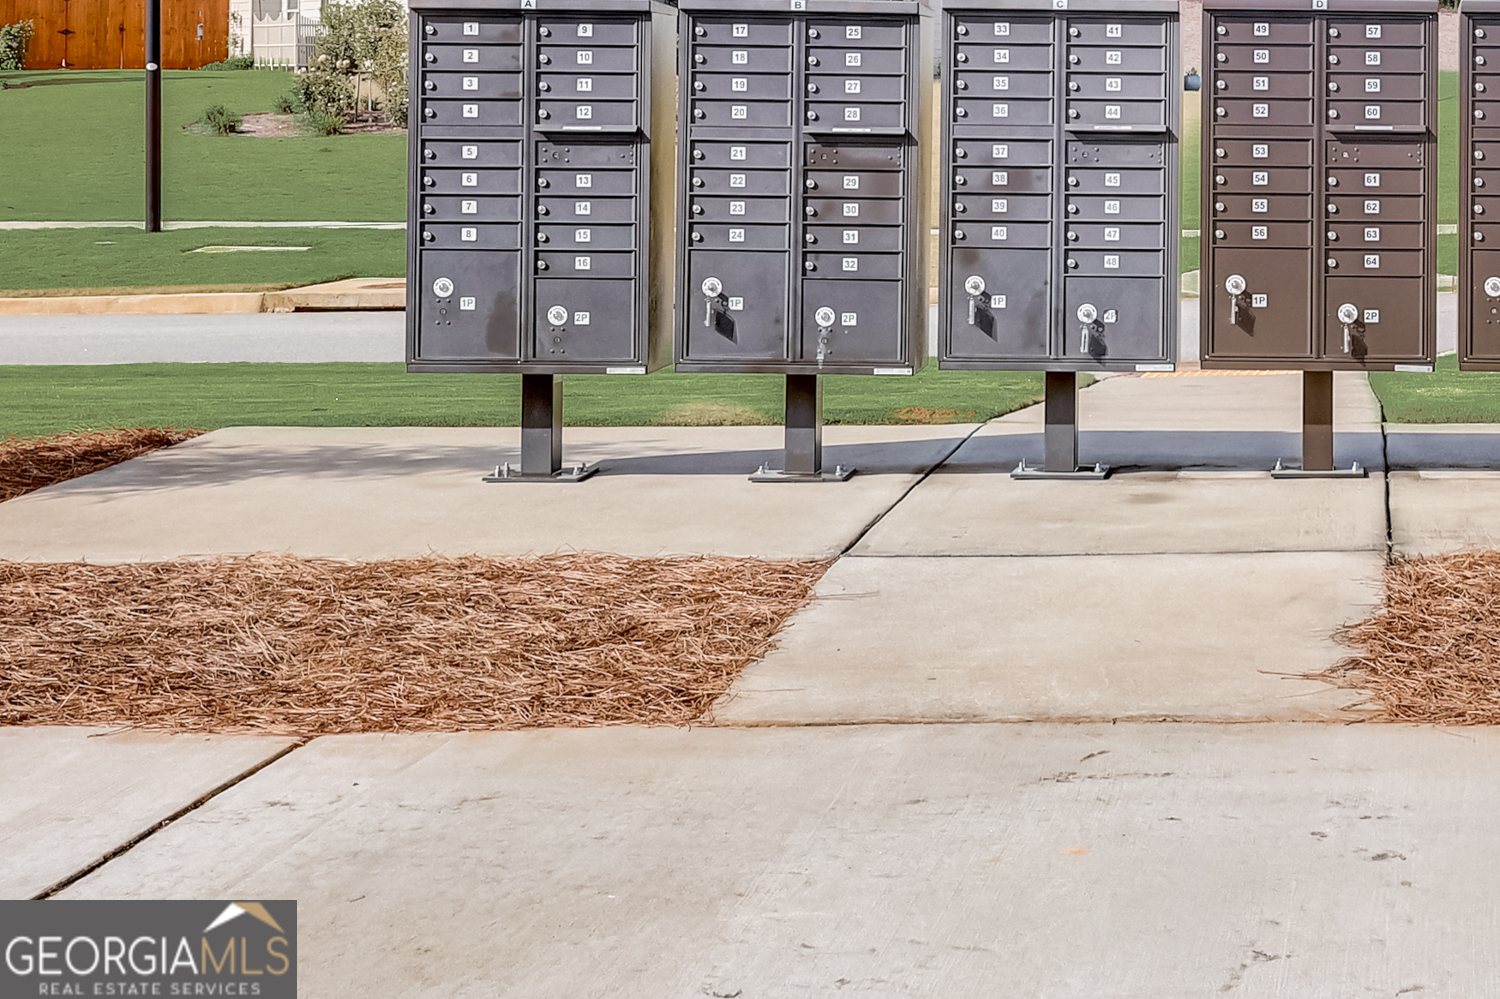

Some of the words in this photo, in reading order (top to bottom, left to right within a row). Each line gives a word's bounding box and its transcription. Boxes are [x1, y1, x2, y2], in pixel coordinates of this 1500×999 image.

[524, 0, 532, 8] A
[794, 1, 802, 9] B
[1056, 0, 1064, 8] C
[1316, 0, 1324, 8] D
[468, 24, 473, 33] 1
[581, 25, 588, 34] 9
[735, 26, 746, 35] 17
[847, 27, 860, 37] 25
[996, 24, 1008, 34] 33
[1108, 26, 1119, 35] 41
[1255, 24, 1267, 34] 49
[1367, 26, 1379, 36] 57
[467, 51, 474, 60] 2
[579, 52, 590, 62] 10
[734, 53, 746, 62] 18
[847, 55, 859, 64] 26
[996, 51, 1008, 61] 34
[1107, 53, 1119, 62] 42
[1255, 51, 1267, 61] 50
[1367, 53, 1379, 63] 58
[467, 78, 474, 88] 3
[578, 80, 589, 89] 11
[734, 80, 746, 89] 19
[847, 82, 859, 91] 27
[995, 78, 1006, 88] 35
[1107, 80, 1119, 89] 43
[1255, 79, 1266, 88] 51
[1367, 81, 1379, 90] 59
[467, 106, 473, 115] 4
[578, 107, 590, 117] 12
[733, 107, 745, 117] 20
[846, 109, 858, 119] 28
[994, 106, 1007, 115] 36
[1106, 107, 1118, 116] 44
[1255, 106, 1266, 115] 52
[1366, 107, 1378, 117] 60
[466, 147, 473, 156] 5
[732, 148, 744, 158] 21
[994, 146, 1006, 156] 37
[1254, 146, 1266, 156] 53
[466, 174, 473, 184] 6
[578, 176, 589, 185] 13
[732, 176, 744, 186] 22
[845, 177, 857, 187] 29
[994, 173, 1006, 183] 38
[1106, 175, 1119, 185] 45
[1254, 174, 1266, 183] 54
[1366, 175, 1377, 184] 61
[465, 202, 472, 211] 7
[577, 203, 588, 212] 14
[731, 203, 744, 213] 23
[845, 205, 857, 215] 30
[993, 201, 1006, 211] 39
[1106, 202, 1118, 212] 46
[1254, 201, 1266, 210] 55
[1366, 202, 1378, 211] 62
[465, 229, 472, 239] 8
[577, 230, 589, 240] 15
[731, 230, 743, 240] 24
[844, 232, 856, 242] 31
[993, 228, 1005, 238] 40
[1106, 229, 1118, 239] 47
[1254, 228, 1266, 237] 56
[1366, 229, 1378, 239] 63
[577, 258, 589, 267] 16
[844, 259, 856, 269] 32
[1105, 257, 1117, 266] 48
[1366, 257, 1377, 266] 64
[462, 298, 474, 308] 1P
[730, 298, 742, 308] 1P
[992, 296, 1005, 306] 1P
[1253, 296, 1266, 305] 1P
[576, 313, 588, 322] 2P
[843, 314, 855, 323] 2P
[1365, 311, 1377, 321] 2P
